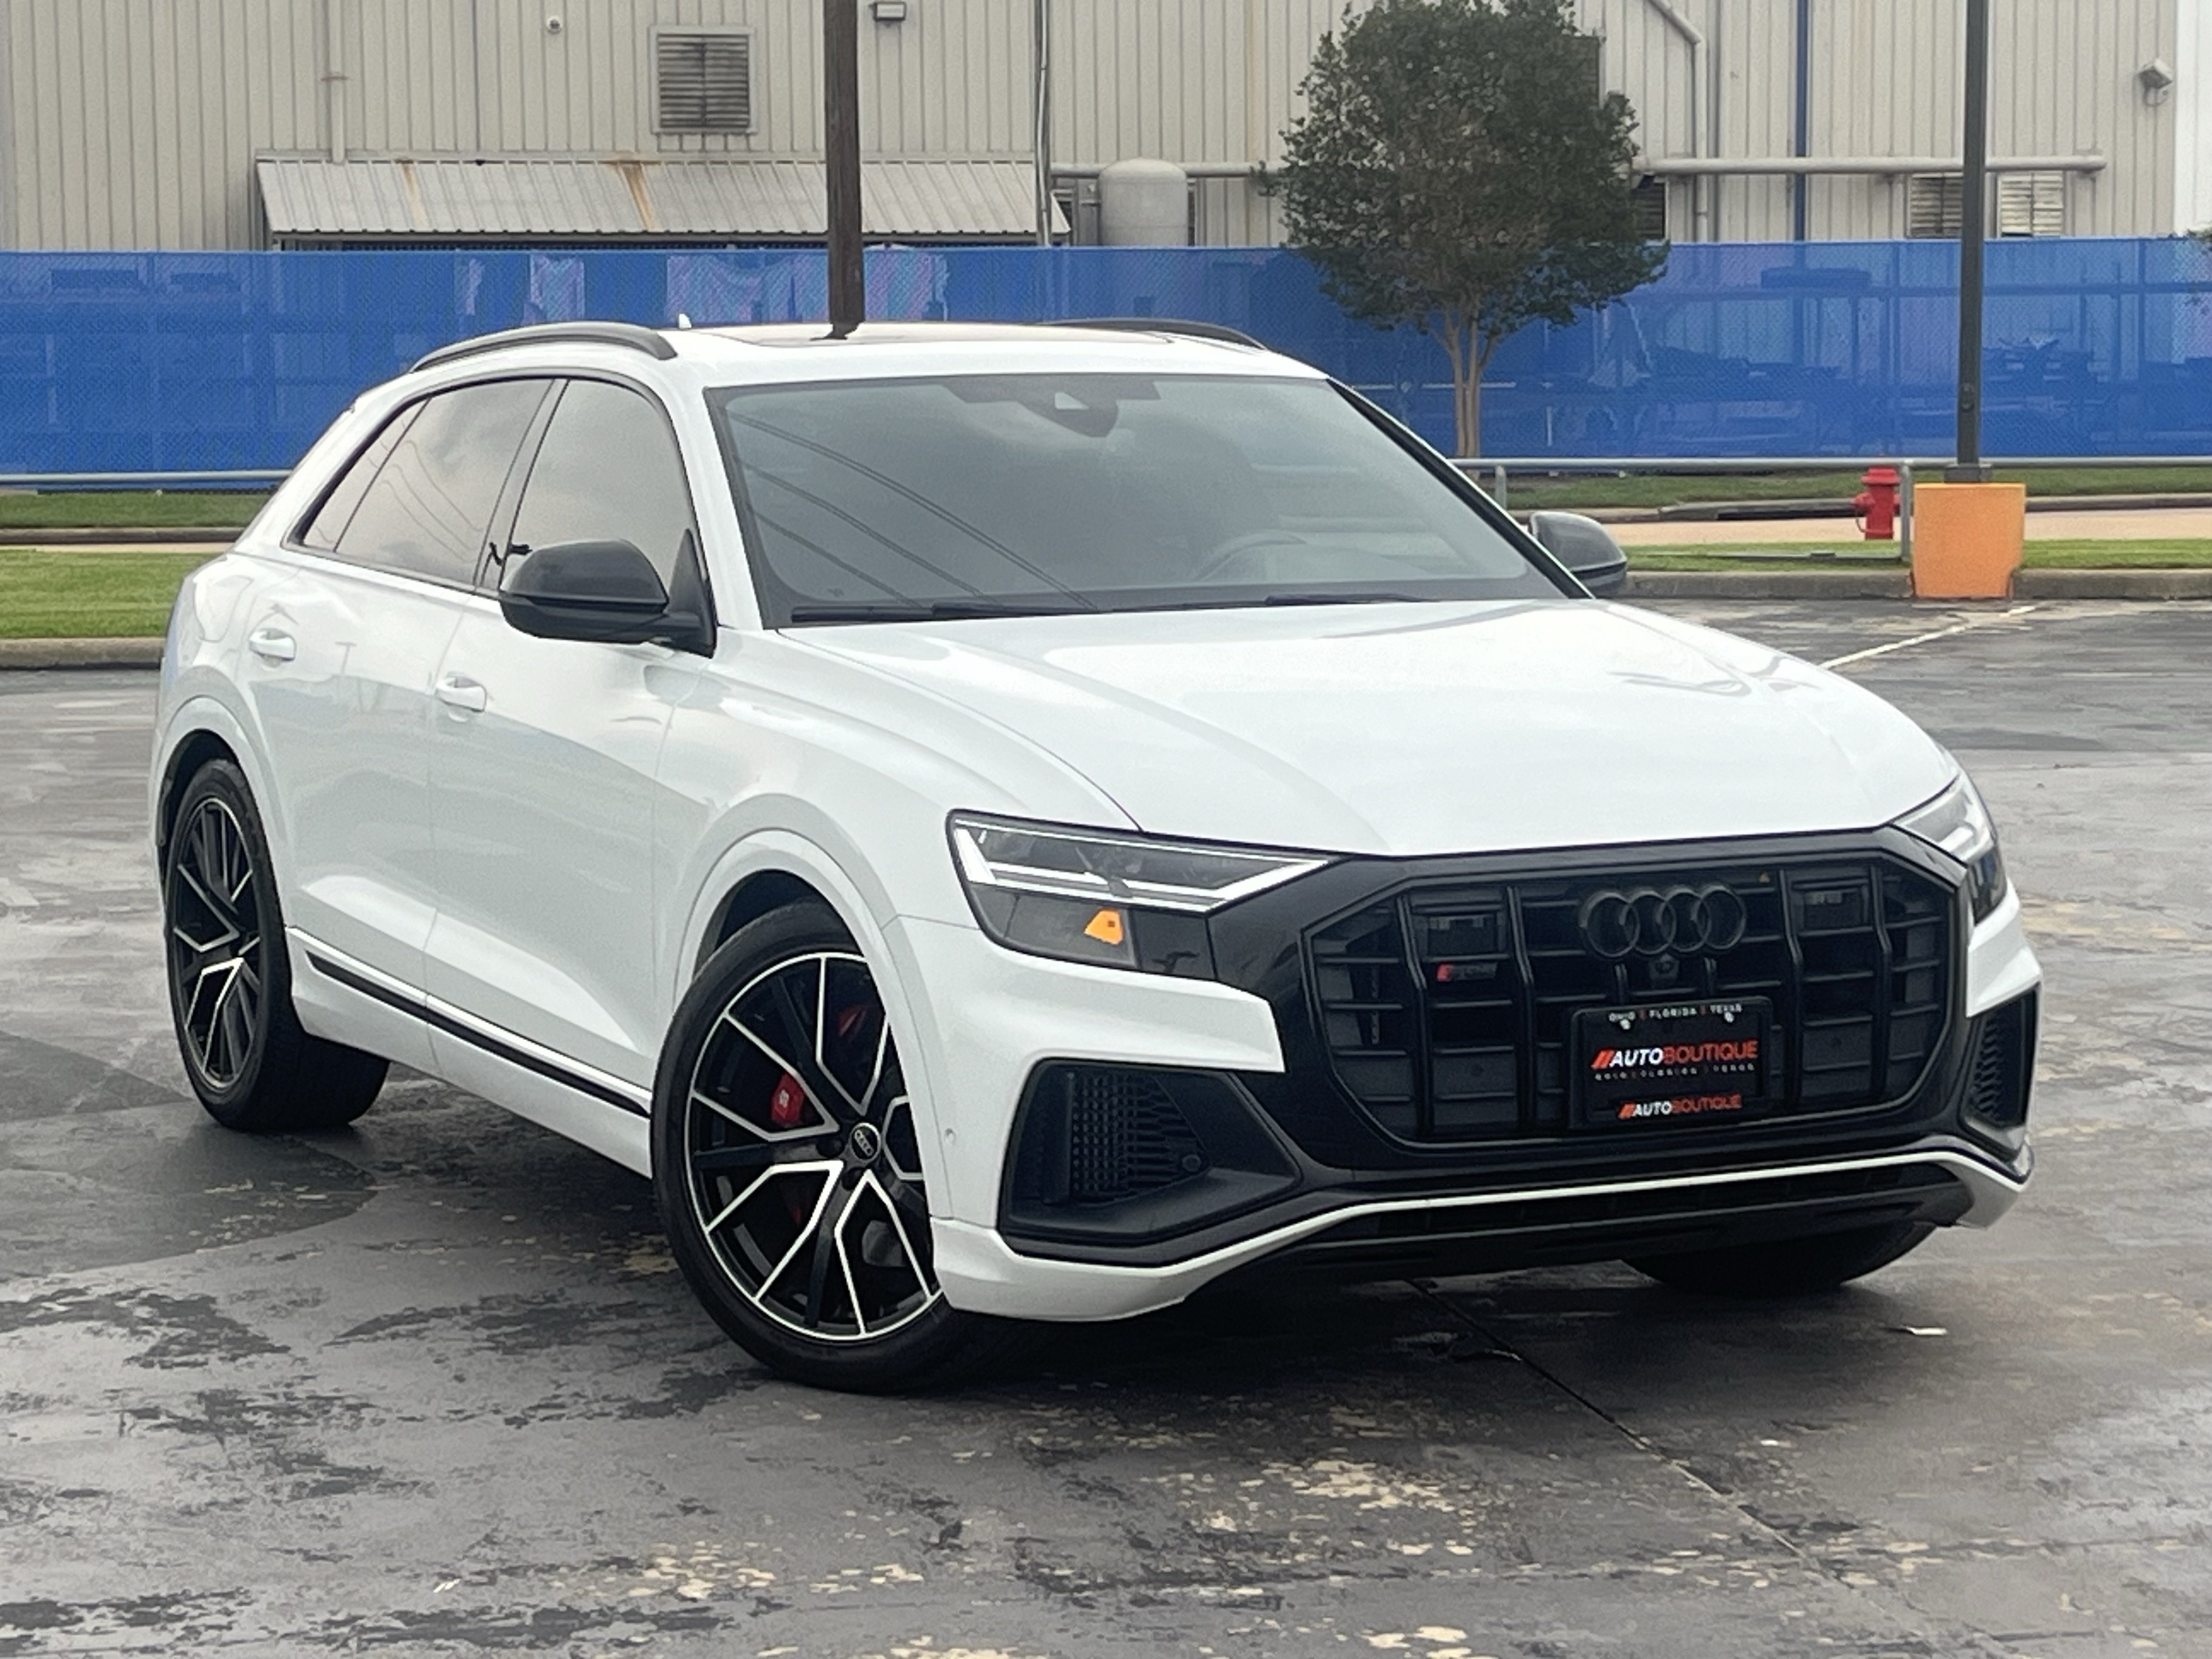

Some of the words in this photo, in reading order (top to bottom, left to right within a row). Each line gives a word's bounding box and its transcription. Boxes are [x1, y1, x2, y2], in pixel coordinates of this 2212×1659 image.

[1649, 1007, 1697, 1019] FLORIDA
[1609, 1041, 1758, 1067] AUTOBOUTIQUE
[1632, 1093, 1741, 1117] AUTOBOUTIQUE
